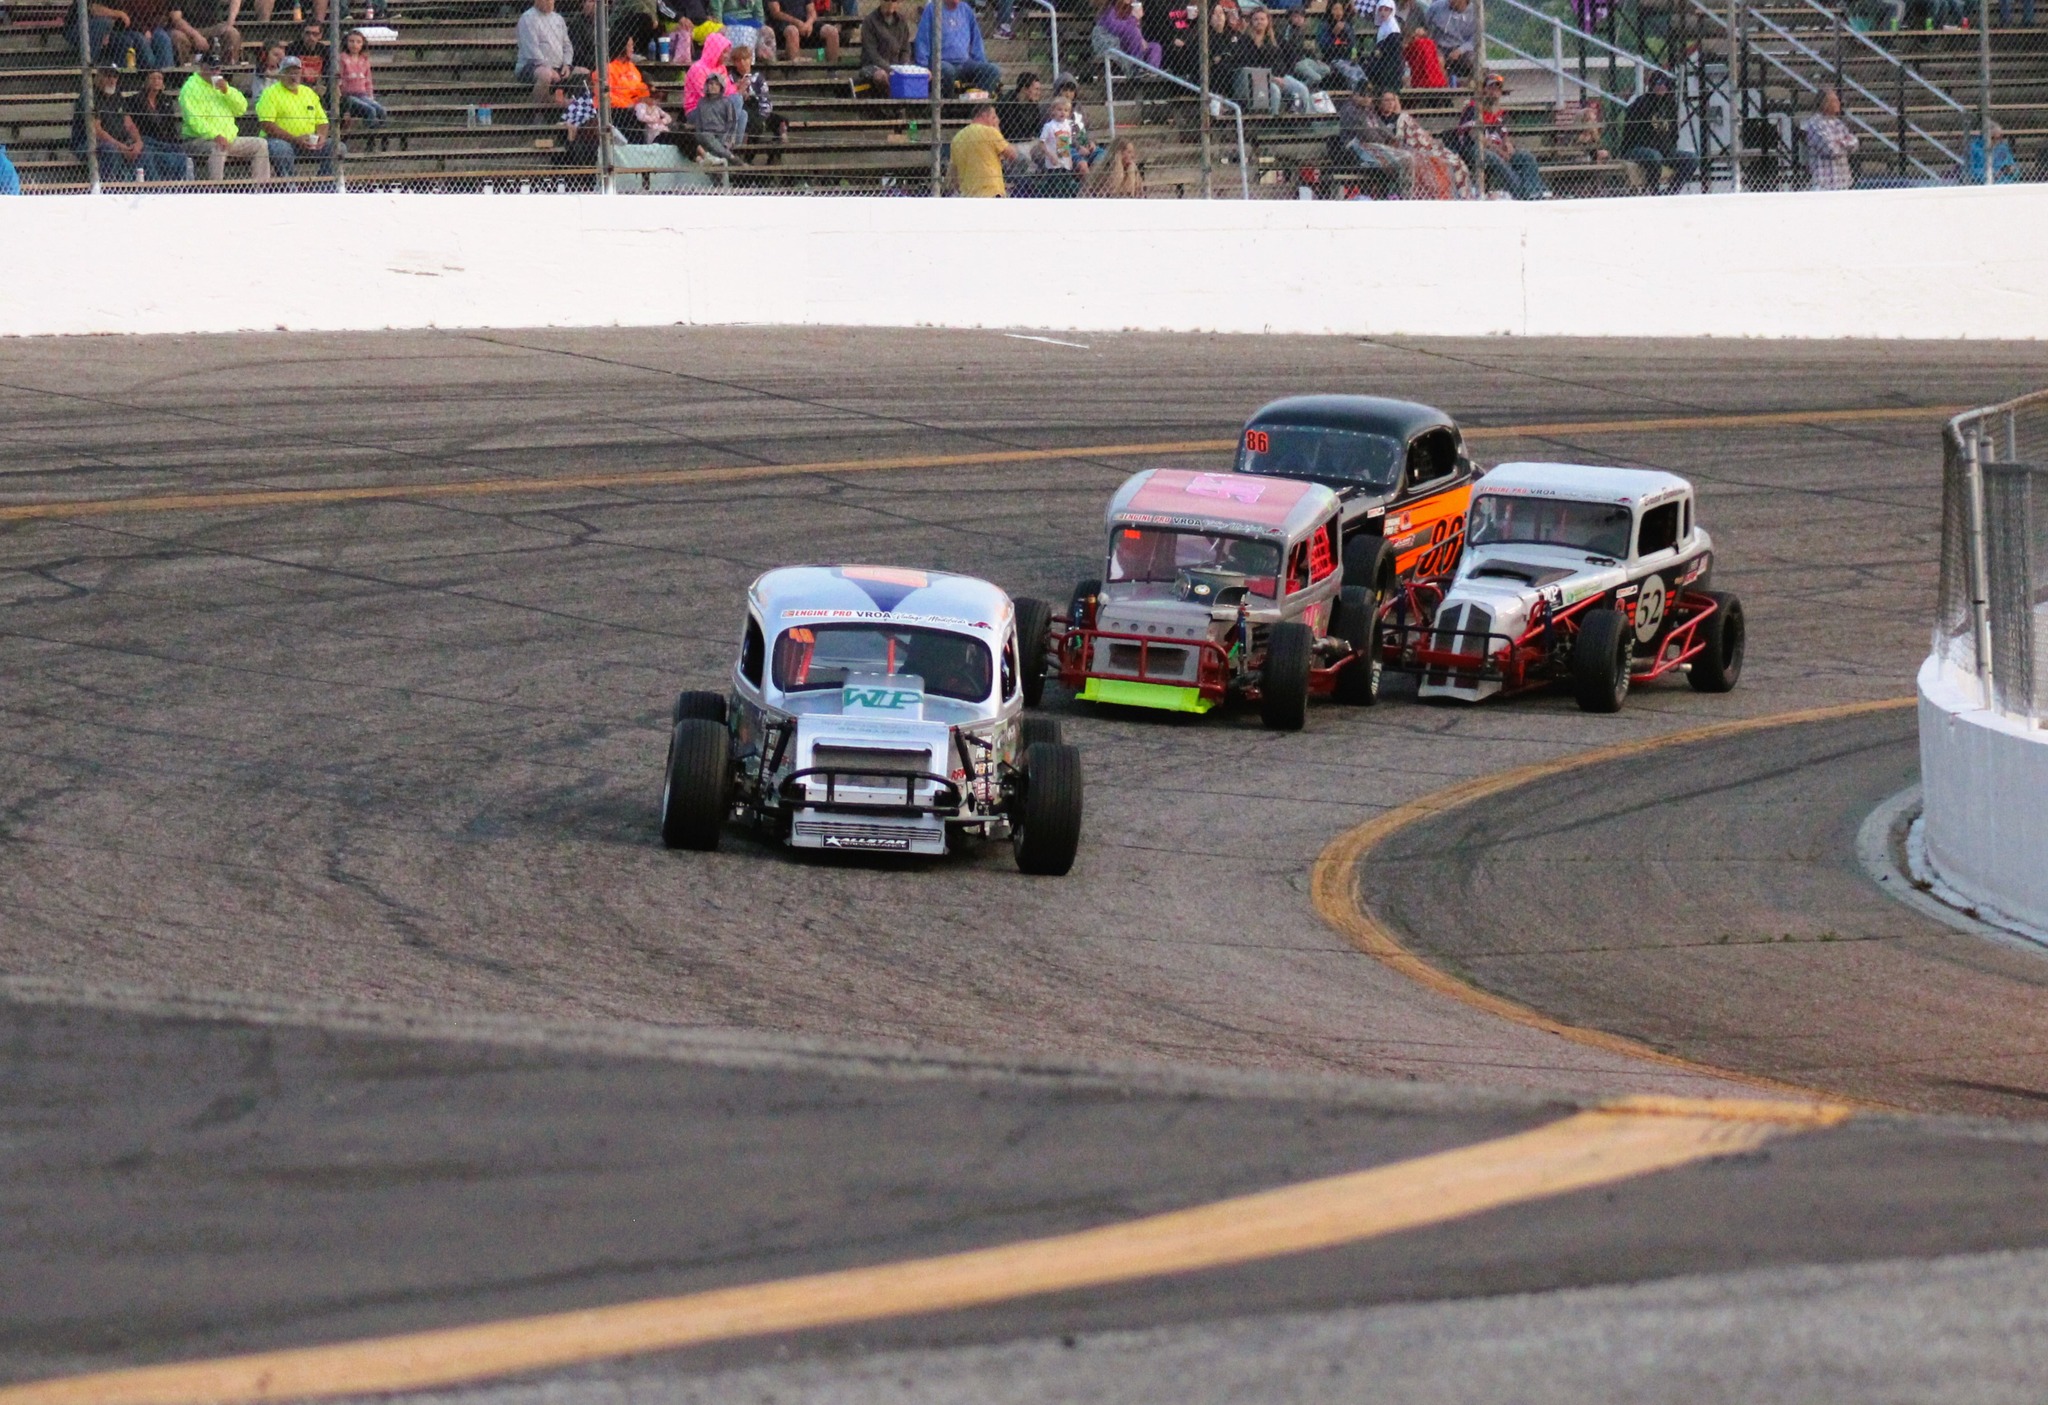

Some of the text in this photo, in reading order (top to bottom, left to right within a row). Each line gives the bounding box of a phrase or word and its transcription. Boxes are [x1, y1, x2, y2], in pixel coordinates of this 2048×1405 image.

[1246, 430, 1268, 453] 86
[1512, 487, 1527, 495] PRO
[1153, 515, 1172, 524] PRO
[1173, 517, 1202, 526] VROA
[832, 610, 852, 618] PRO
[856, 611, 891, 619] VROA
[1637, 589, 1662, 629] 52
